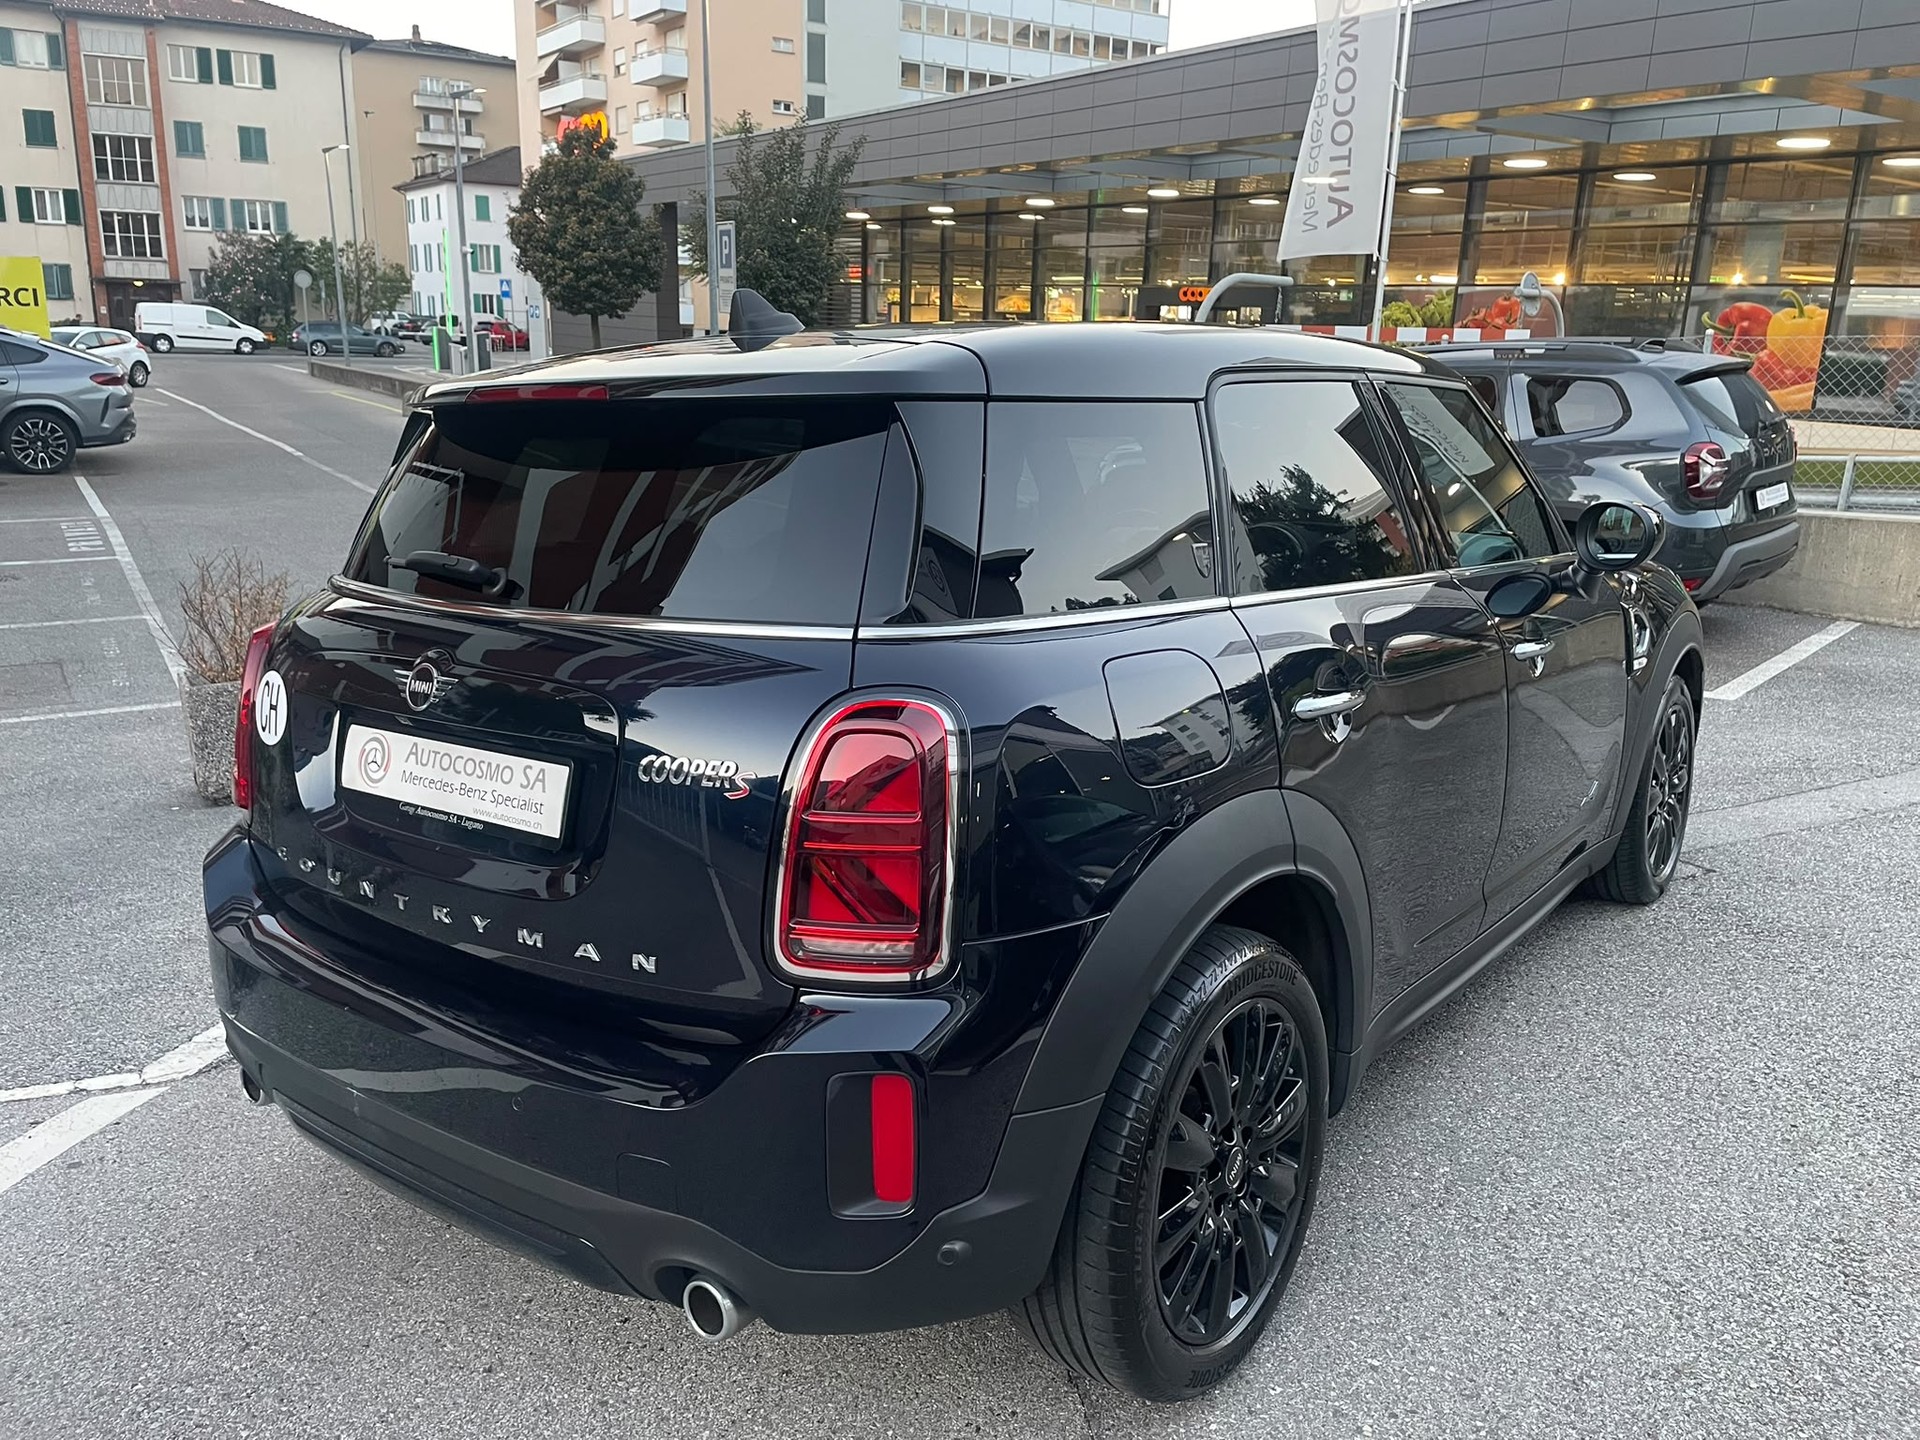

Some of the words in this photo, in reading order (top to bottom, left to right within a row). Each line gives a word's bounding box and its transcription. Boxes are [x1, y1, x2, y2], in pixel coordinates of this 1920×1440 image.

[722, 236, 729, 265] P
[410, 679, 433, 694] MINI
[260, 679, 281, 736] CH
[400, 769, 487, 801] Mercedes-Benz
[490, 789, 545, 815] Specialist
[520, 764, 547, 793] SA
[415, 806, 448, 821] Autocosmo
[448, 814, 457, 824] SA
[461, 817, 484, 830] Lugano
[472, 807, 543, 830] www.autocosmo.ch
[276, 846, 657, 974] COUNTRYMAN
[1224, 959, 1299, 1006] BRIDGESTONE
[1229, 1153, 1242, 1181] MINI
